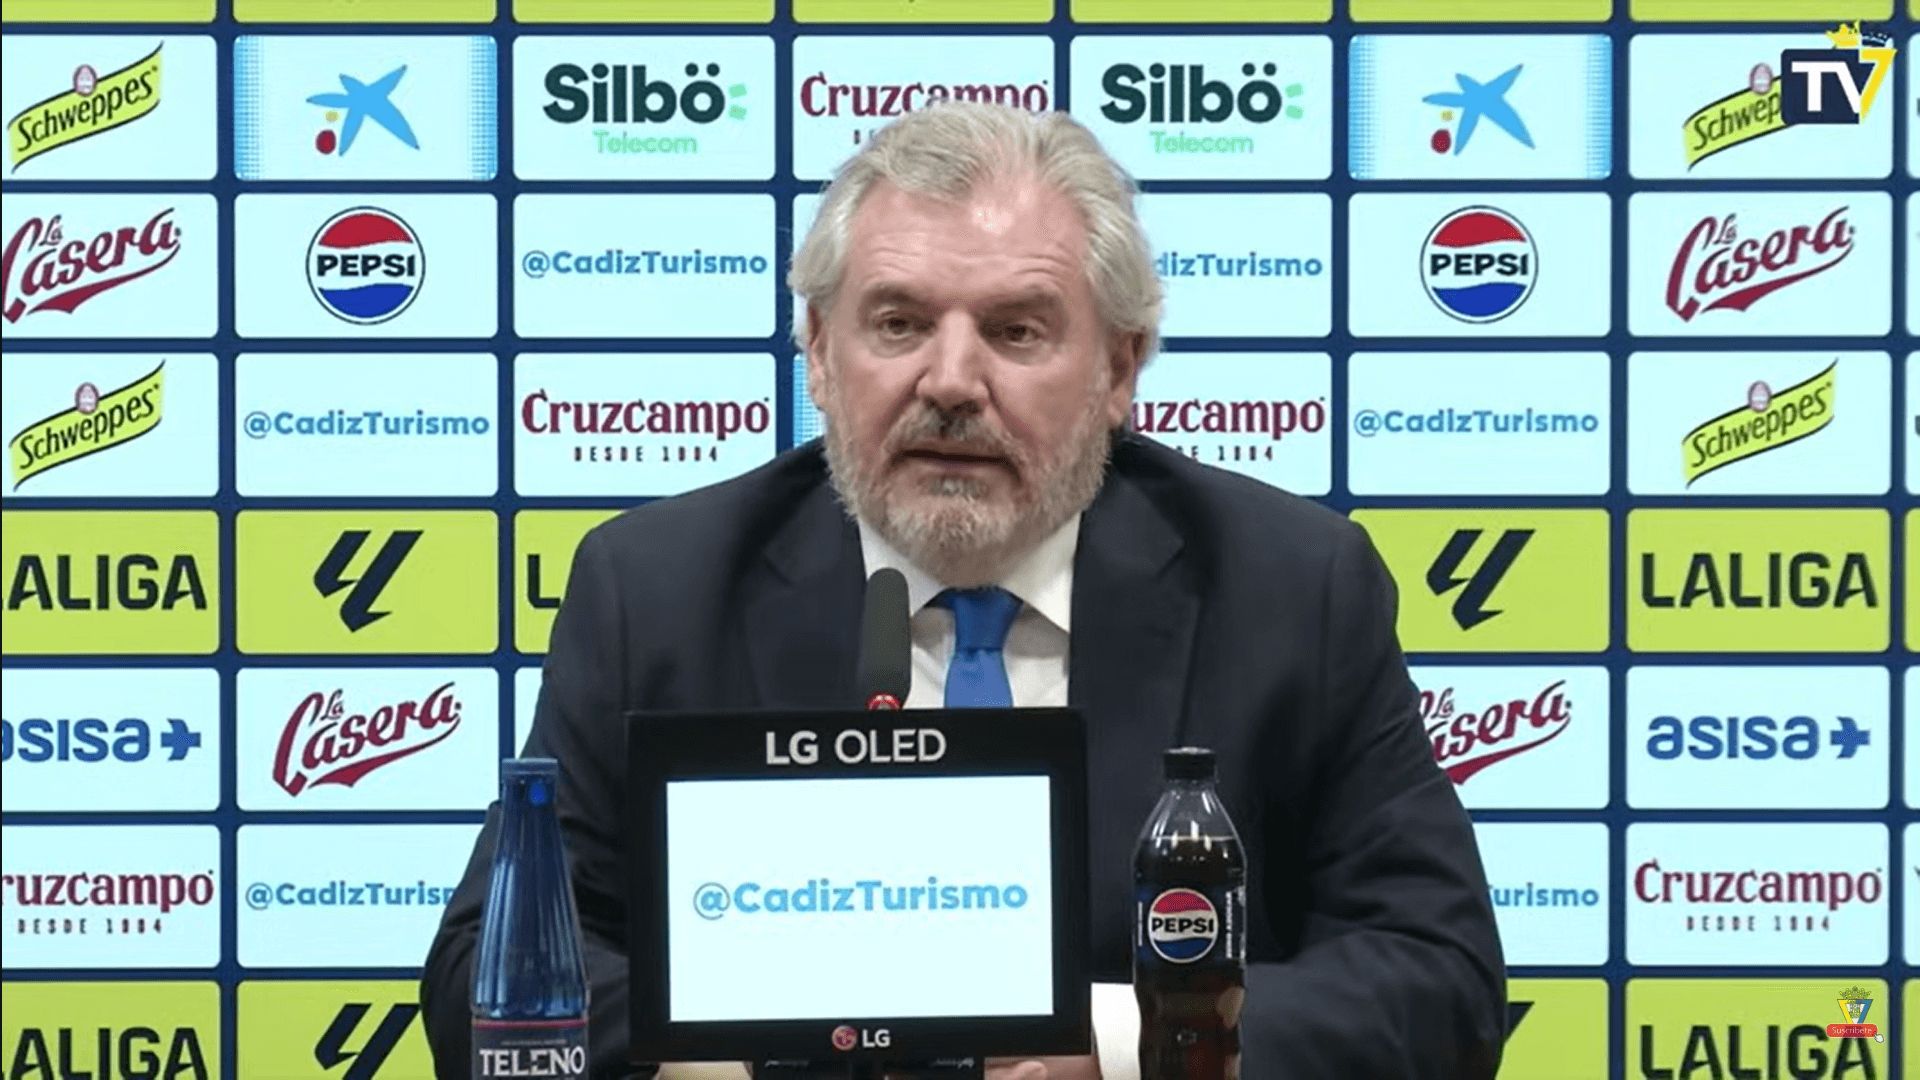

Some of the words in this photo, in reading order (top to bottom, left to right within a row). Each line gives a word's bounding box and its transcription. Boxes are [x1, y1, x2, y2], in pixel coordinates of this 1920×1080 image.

[16, 66, 158, 153] Schweppes
[541, 61, 727, 125] Silbö
[1098, 61, 1284, 125] Silbö
[592, 130, 698, 155] Telecom
[1149, 130, 1255, 155] Telecom
[39, 214, 63, 247] La
[1713, 212, 1737, 246] La
[317, 253, 416, 278] PEPSI
[522, 249, 768, 280] @CadizTurismo
[1430, 253, 1529, 277] PEPSI
[1666, 205, 1855, 322] Casera
[18, 384, 161, 472] Schweppes
[242, 410, 491, 440] @CadizTurismo
[521, 388, 771, 441] Cruzcampo
[1353, 408, 1599, 438] @CadizTurismo
[1691, 382, 1834, 470] Schweppes
[574, 446, 644, 462] DESDE
[1641, 552, 1879, 609] LALIGA
[320, 688, 345, 718] La
[272, 682, 462, 797] Casera
[765, 730, 819, 764] LG
[834, 728, 947, 763] OLED
[1646, 715, 1820, 760] asisa
[692, 876, 1029, 921] @CadizTurismo
[1634, 860, 1882, 910] Cruzcampo
[18, 917, 87, 934] DESDE
[1152, 917, 1214, 933] PEPSI
[1686, 916, 1755, 931] DESDE
[862, 1029, 891, 1047] LG
[479, 1046, 585, 1076] TELENO
